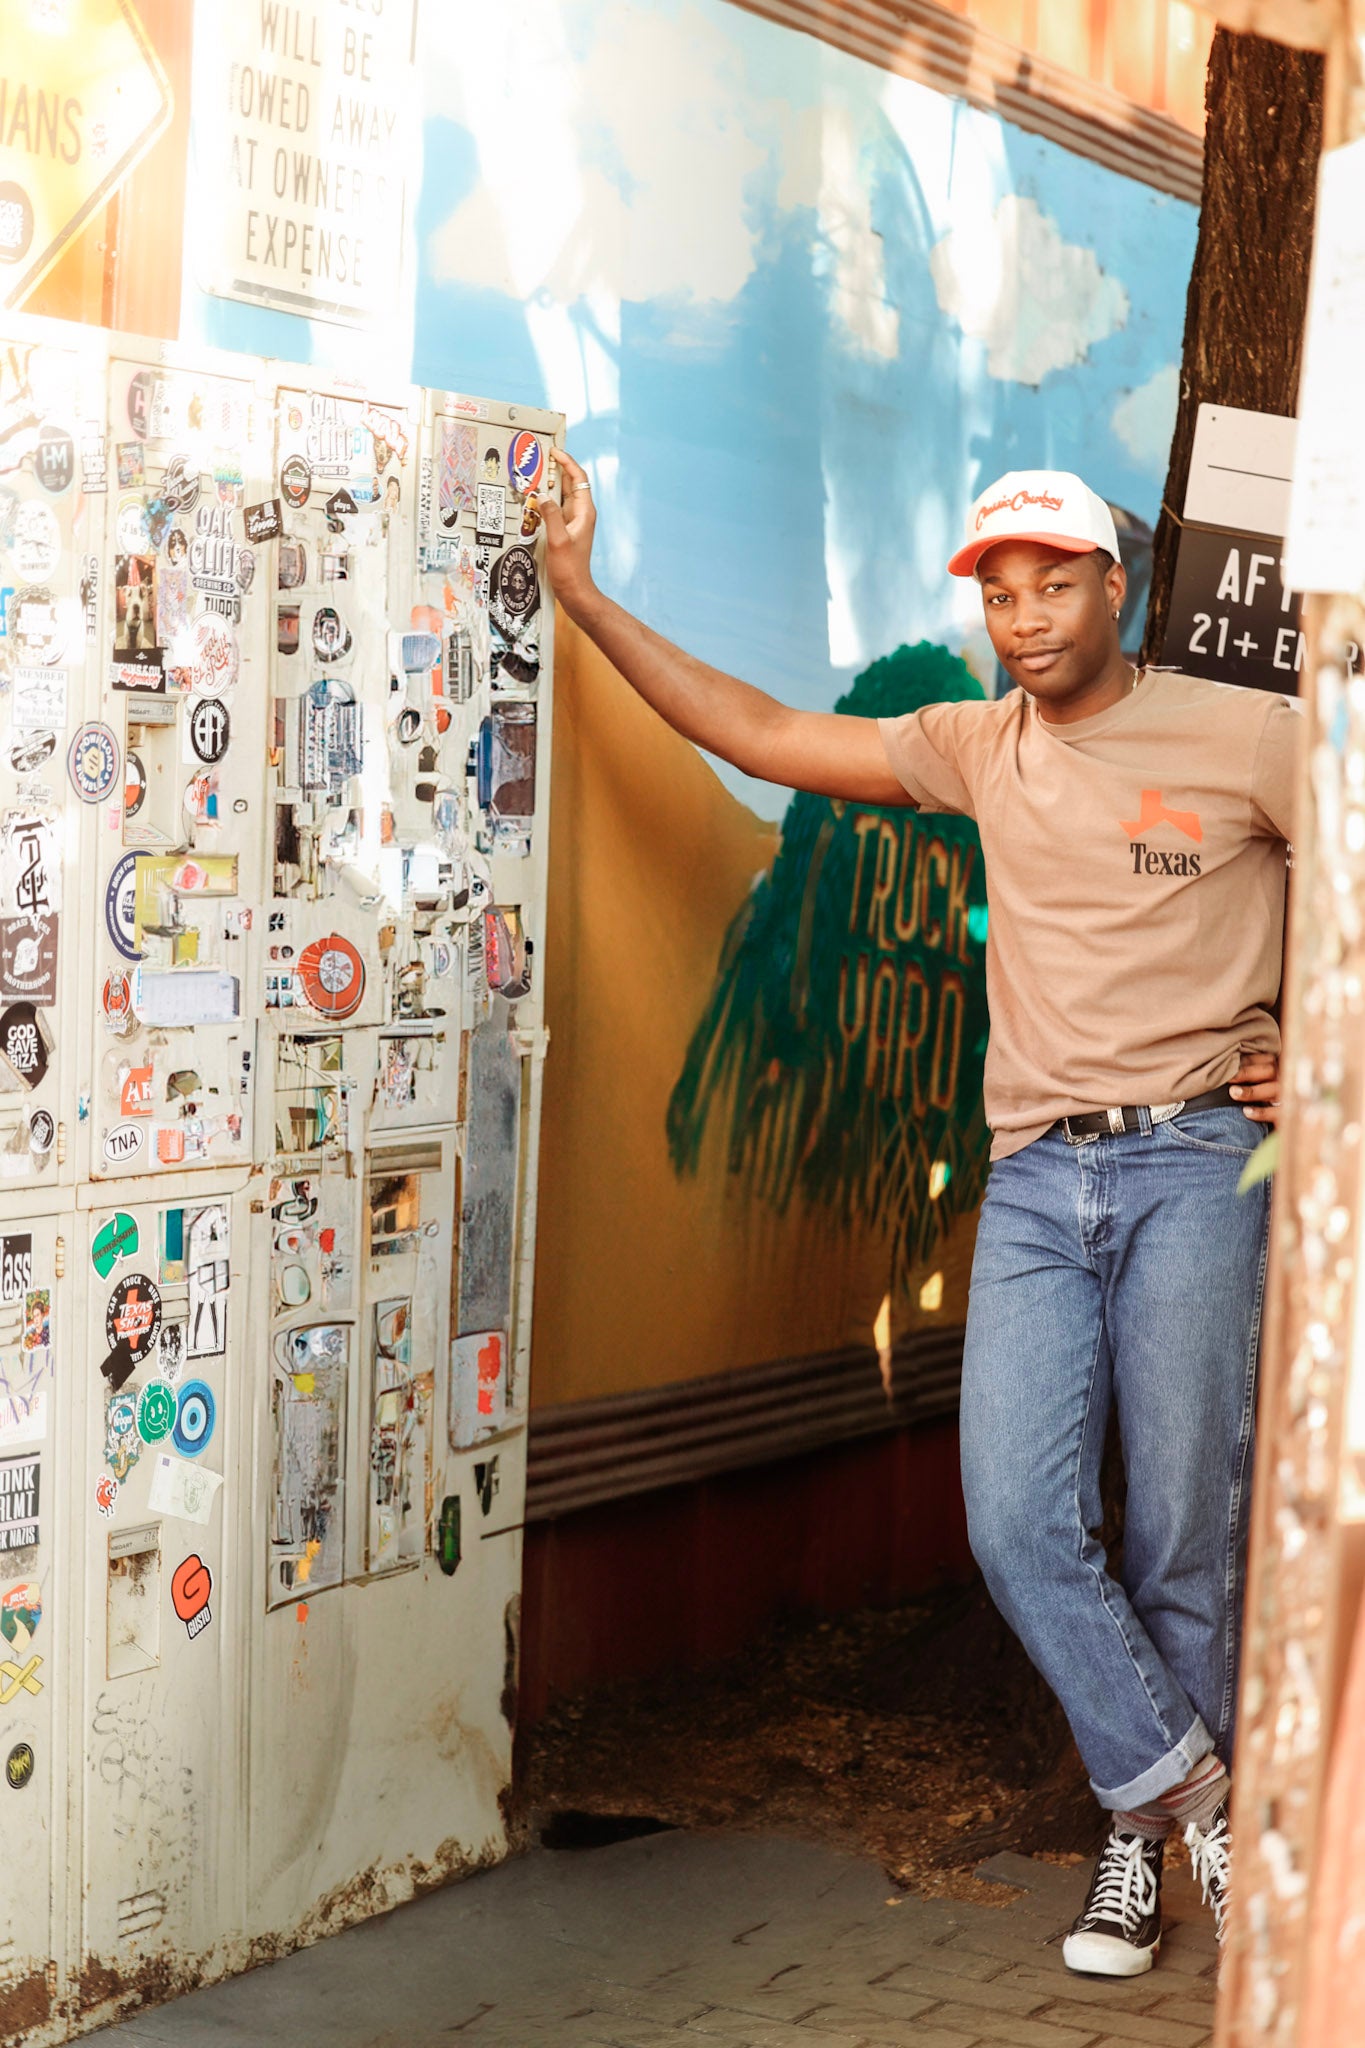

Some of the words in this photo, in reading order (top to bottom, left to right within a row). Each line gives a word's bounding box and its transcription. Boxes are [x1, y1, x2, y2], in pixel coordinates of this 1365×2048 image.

[260, 0, 322, 67] WILL
[343, 26, 373, 82] BE
[231, 64, 310, 133] OWED
[245, 209, 364, 288] EXPENSE
[196, 505, 236, 538] OAK
[189, 540, 241, 577] CLIFF
[501, 551, 534, 587] DEANITUDE
[86, 555, 99, 638] GIRAFFE
[1188, 612, 1259, 658] 21+
[17, 669, 65, 682] MEMBER
[1130, 843, 1202, 877] Texas
[848, 812, 977, 965] TRUCK
[7, 1024, 36, 1041] GOD
[7, 1039, 38, 1056] SAVE
[837, 952, 966, 1116] YARD
[109, 1131, 138, 1154] TNA
[108, 1296, 117, 1314] CAR
[122, 1276, 142, 1288] TRUCK
[148, 1285, 160, 1304] BIKE
[119, 1300, 154, 1319] TEXAS
[9, 1525, 36, 1548] NAZIS
[188, 1605, 210, 1638] GUSTO
